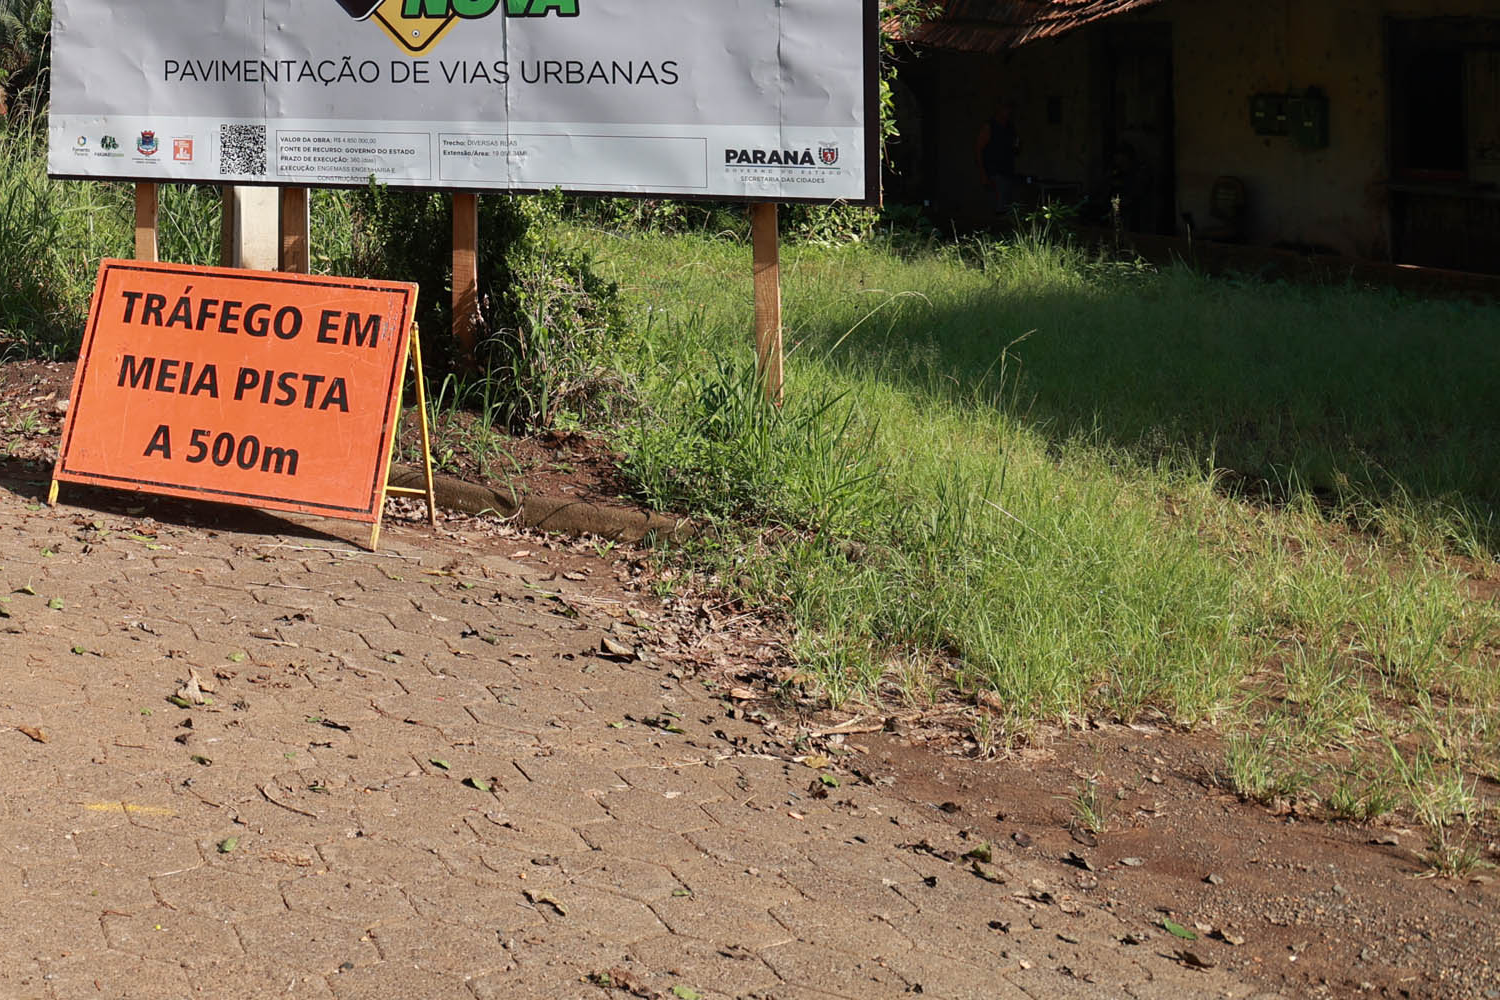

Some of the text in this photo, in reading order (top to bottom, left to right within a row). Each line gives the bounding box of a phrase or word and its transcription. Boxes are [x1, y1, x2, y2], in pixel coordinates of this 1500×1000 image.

[165, 56, 679, 87] PAVIMENTAÇÃO DE VIAS URBANAS
[725, 148, 816, 165] PARANÁ
[122, 286, 382, 349] TRÁFEGO EM
[117, 354, 350, 413] MEIA PISTA
[143, 424, 300, 476] A 500m
